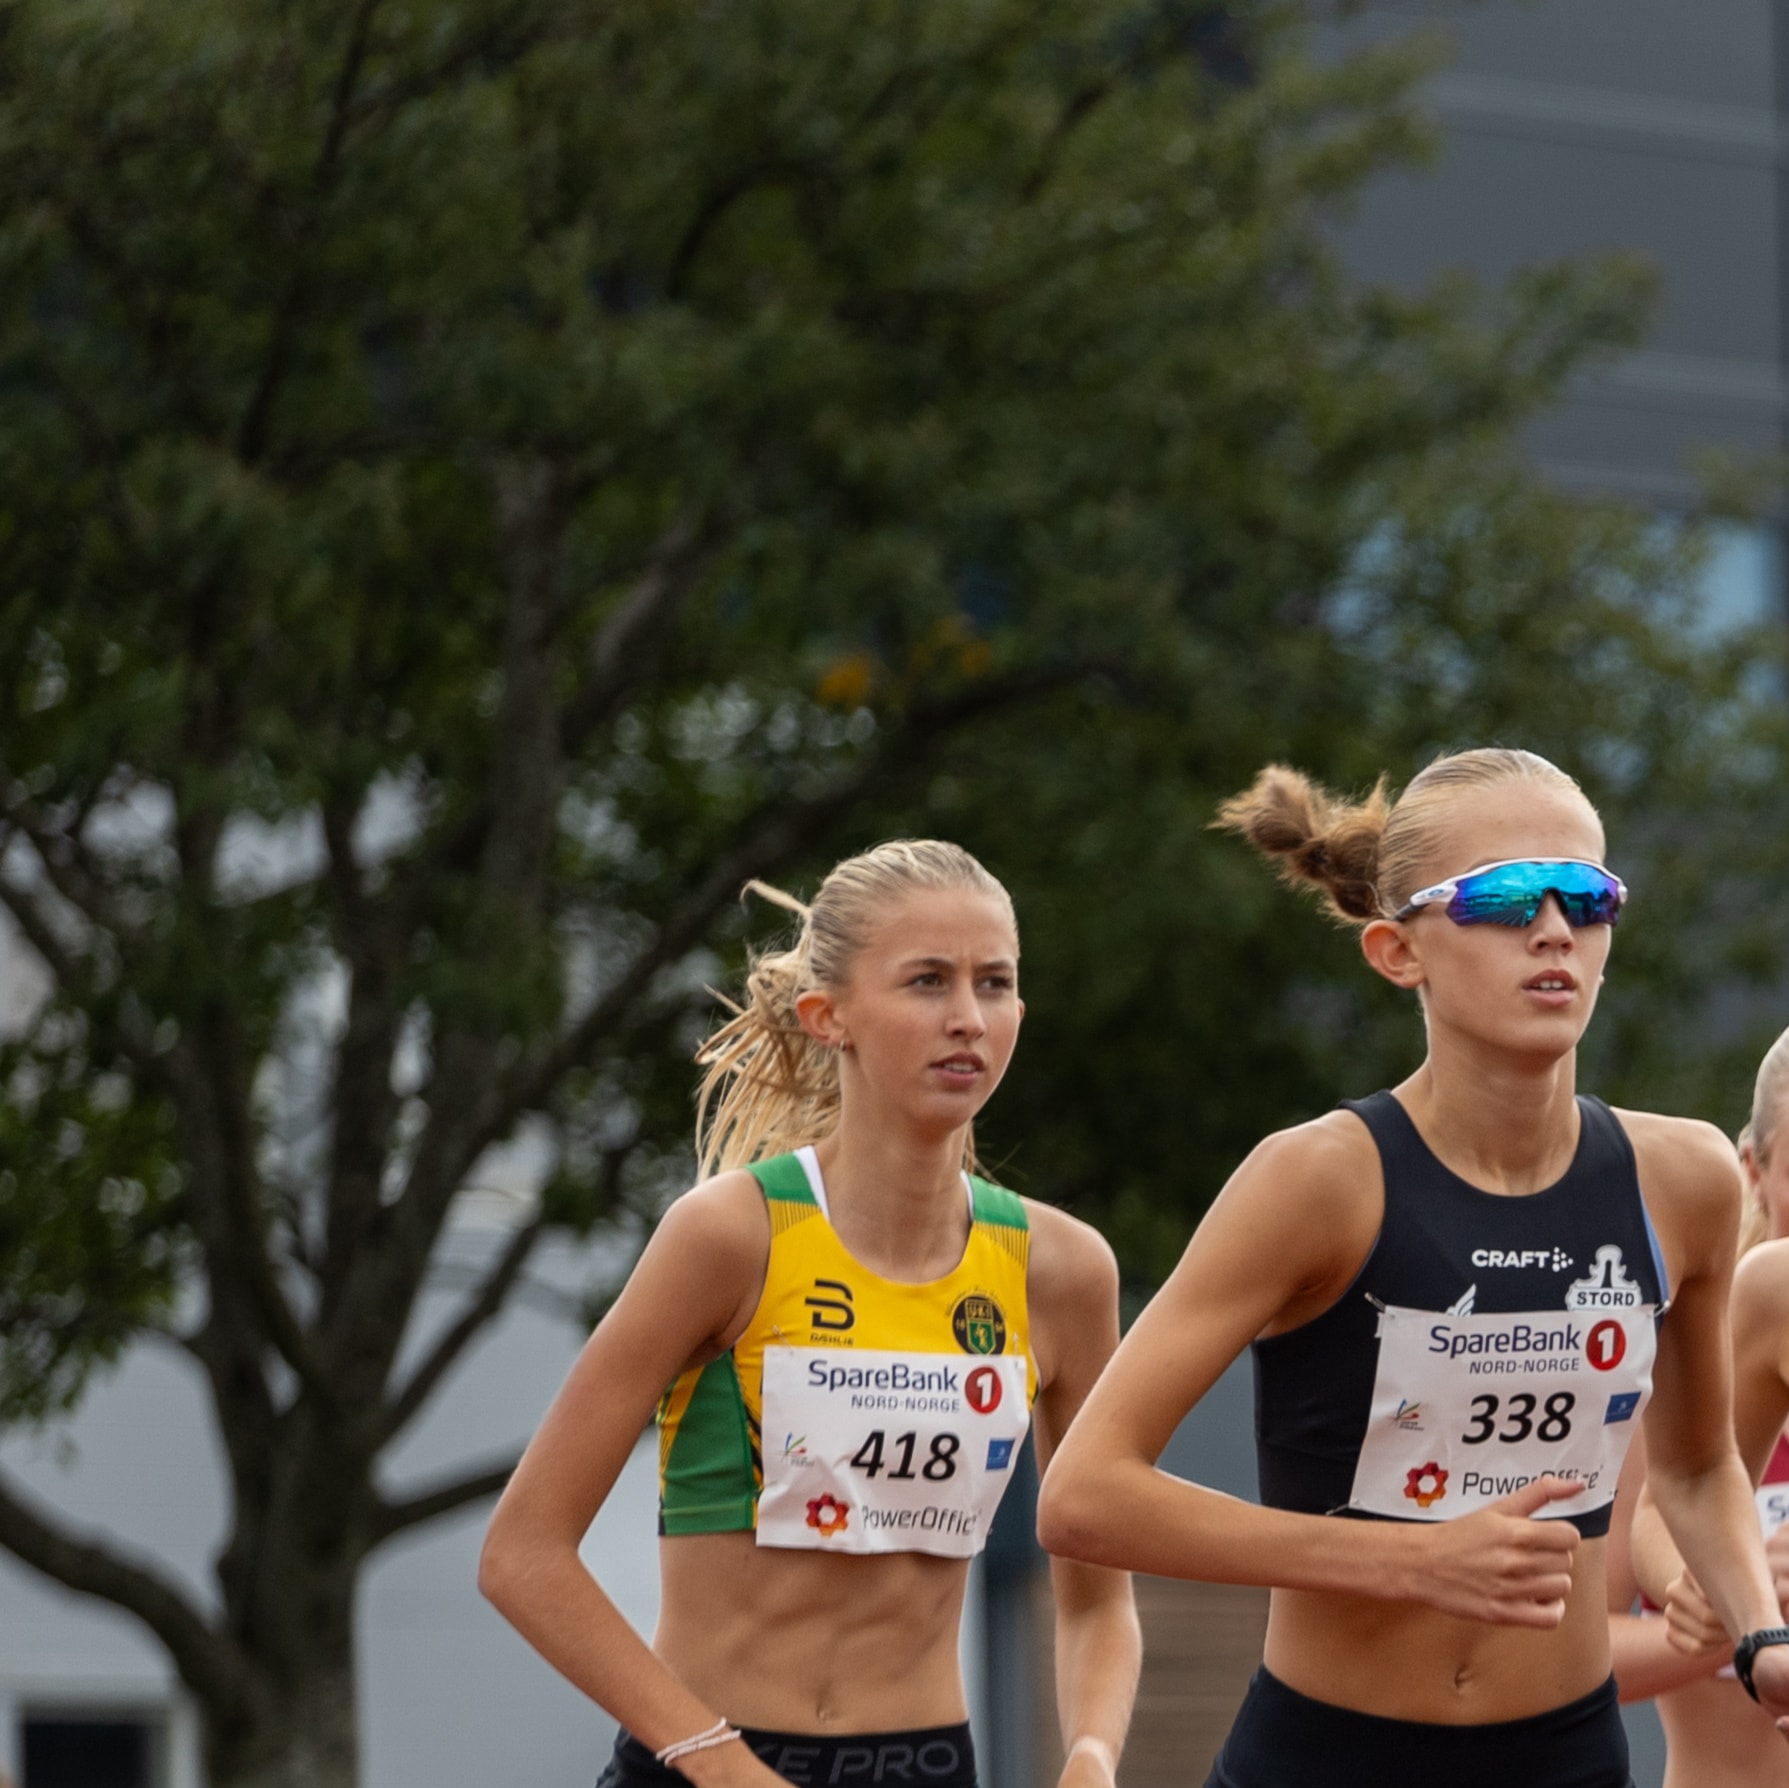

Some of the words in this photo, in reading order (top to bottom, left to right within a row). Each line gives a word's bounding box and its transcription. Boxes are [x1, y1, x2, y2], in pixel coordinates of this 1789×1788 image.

[1471, 1249, 1549, 1268] CRAFT
[1576, 1291, 1635, 1307] STORD
[1429, 1323, 1581, 1359] SpareBank
[808, 1359, 959, 1394] SpareBank
[1469, 1357, 1581, 1375] NORD-NORGE
[850, 1395, 961, 1413] NORD-NORGE
[1461, 1391, 1577, 1445] 338
[850, 1430, 961, 1482] 418
[861, 1504, 978, 1536] PowerOffic
[827, 1740, 959, 1785] PRO
